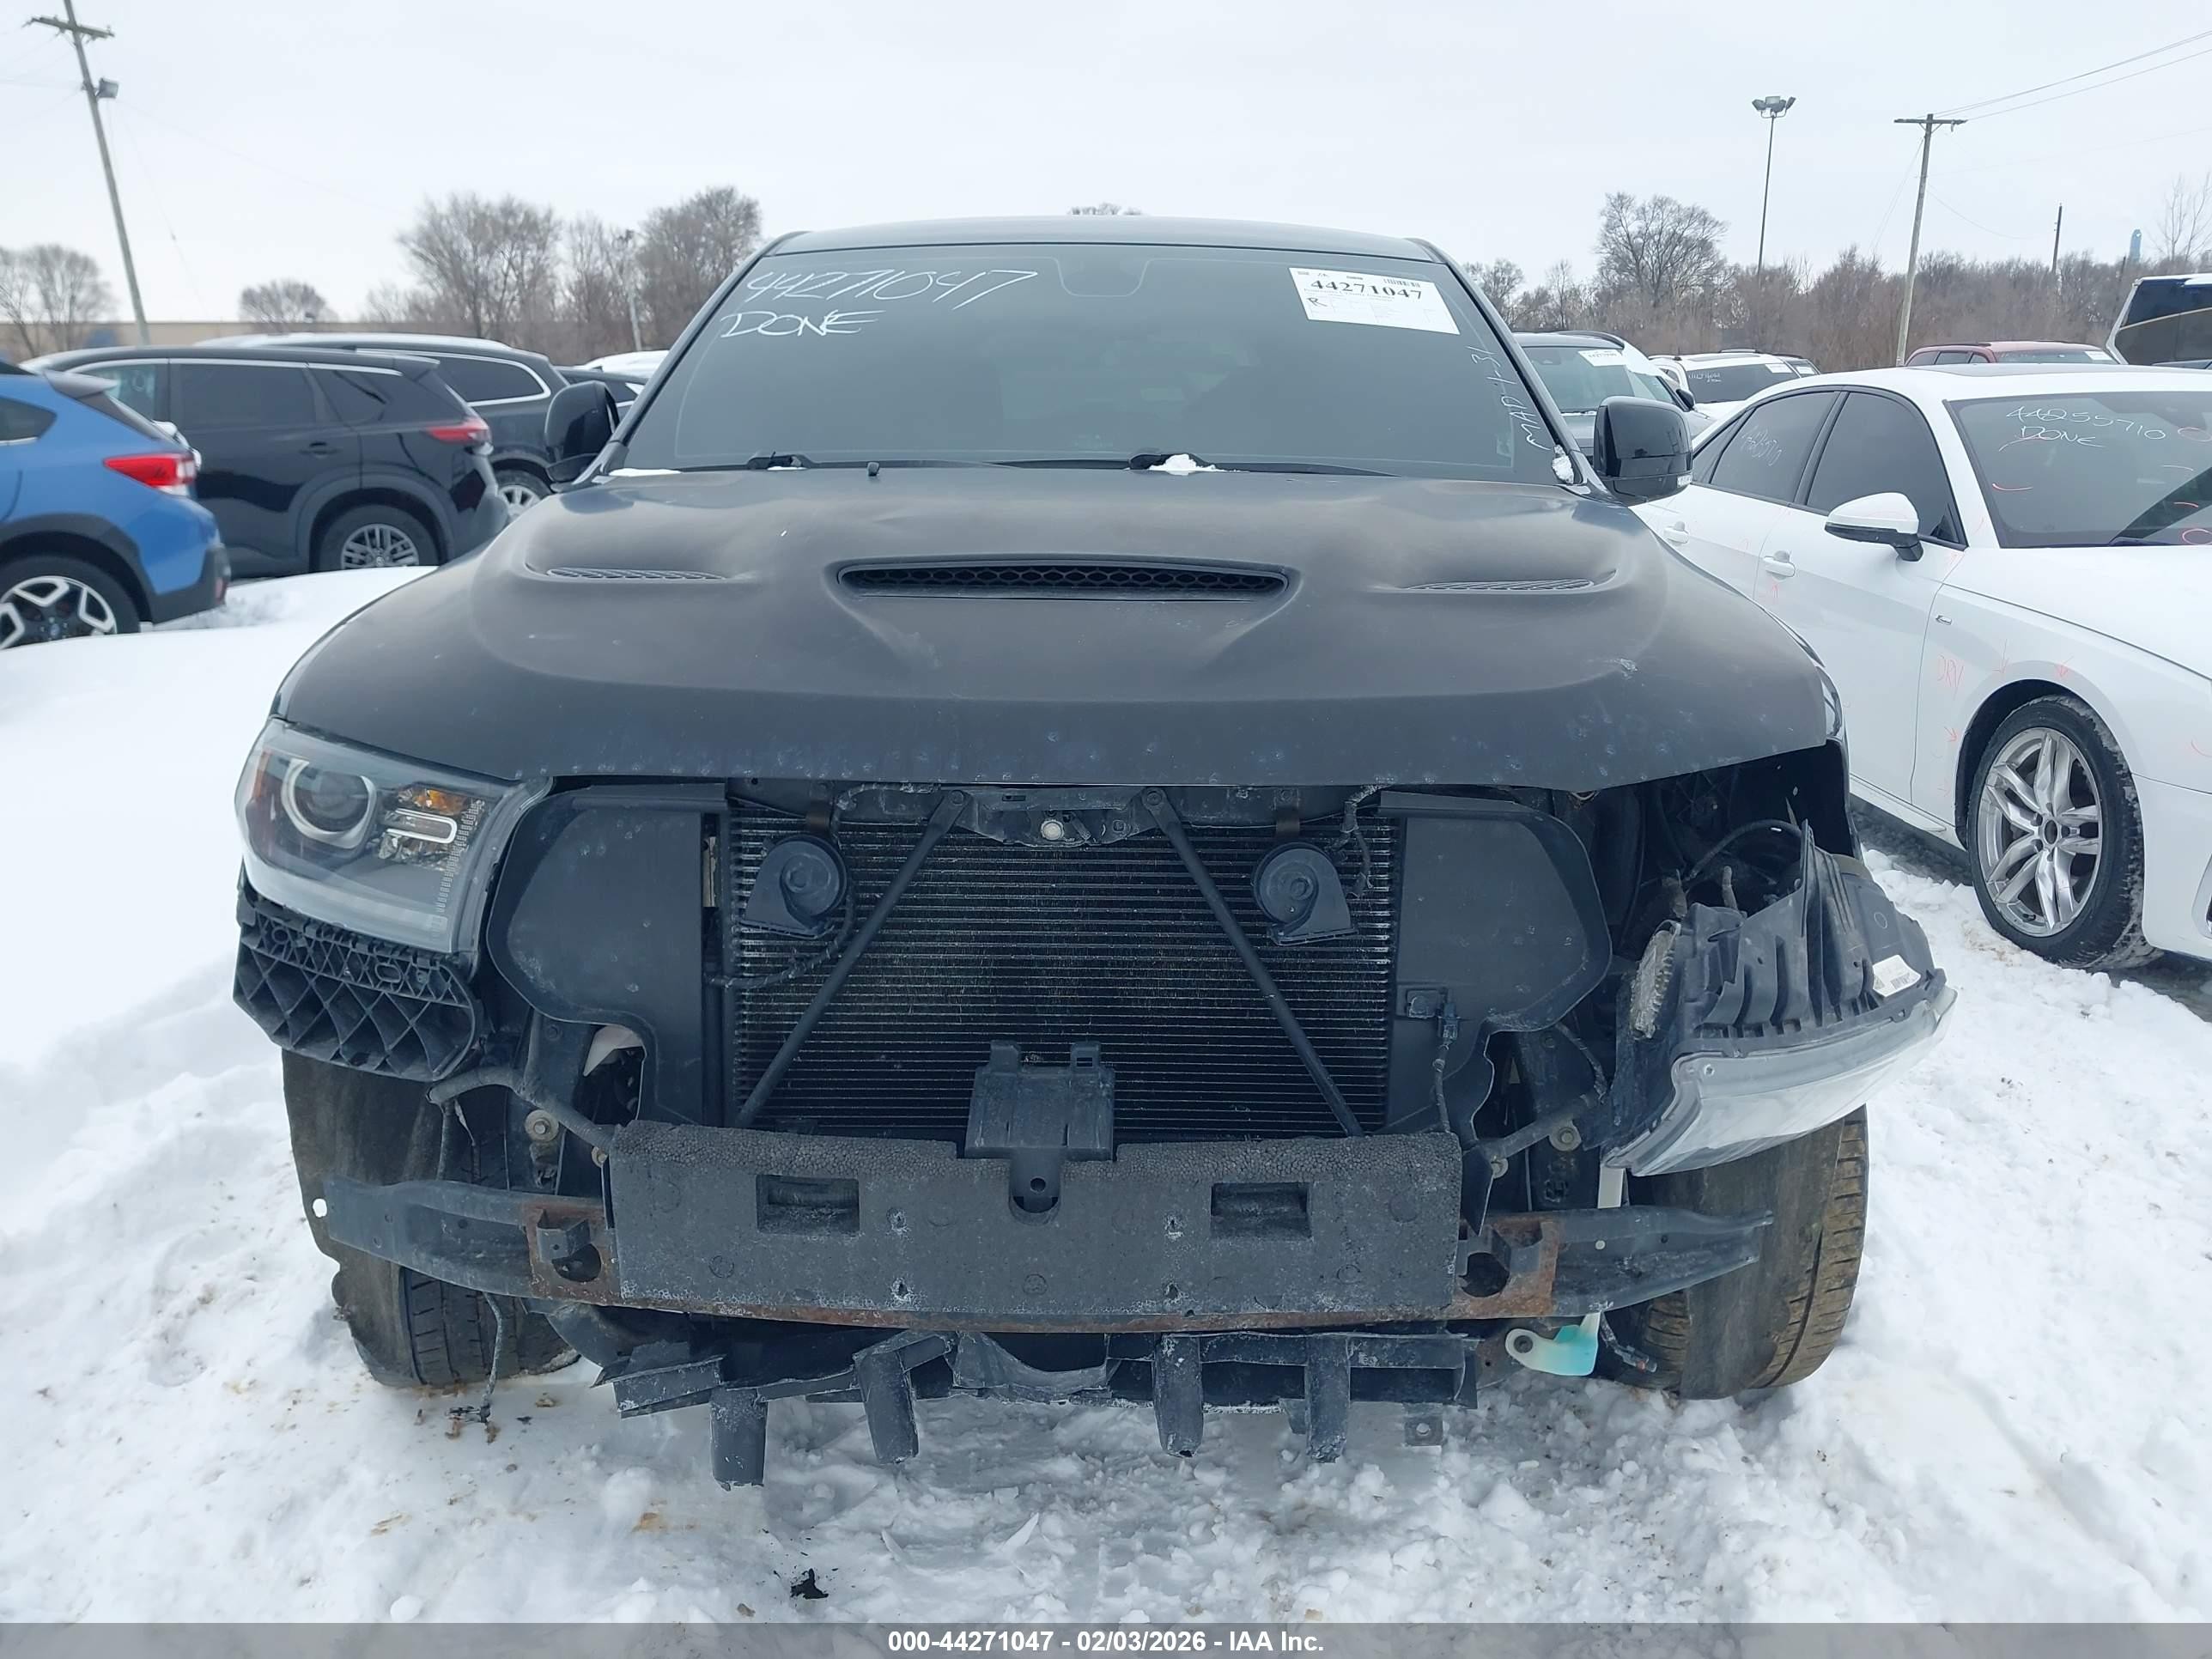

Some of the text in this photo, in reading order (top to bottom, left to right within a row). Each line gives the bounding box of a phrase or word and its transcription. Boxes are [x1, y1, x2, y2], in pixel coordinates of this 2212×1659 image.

[746, 268, 1037, 311] 44271047
[1310, 280, 1422, 300] 44271047
[720, 309, 887, 338] DONE
[2021, 425, 2106, 447] DONE
